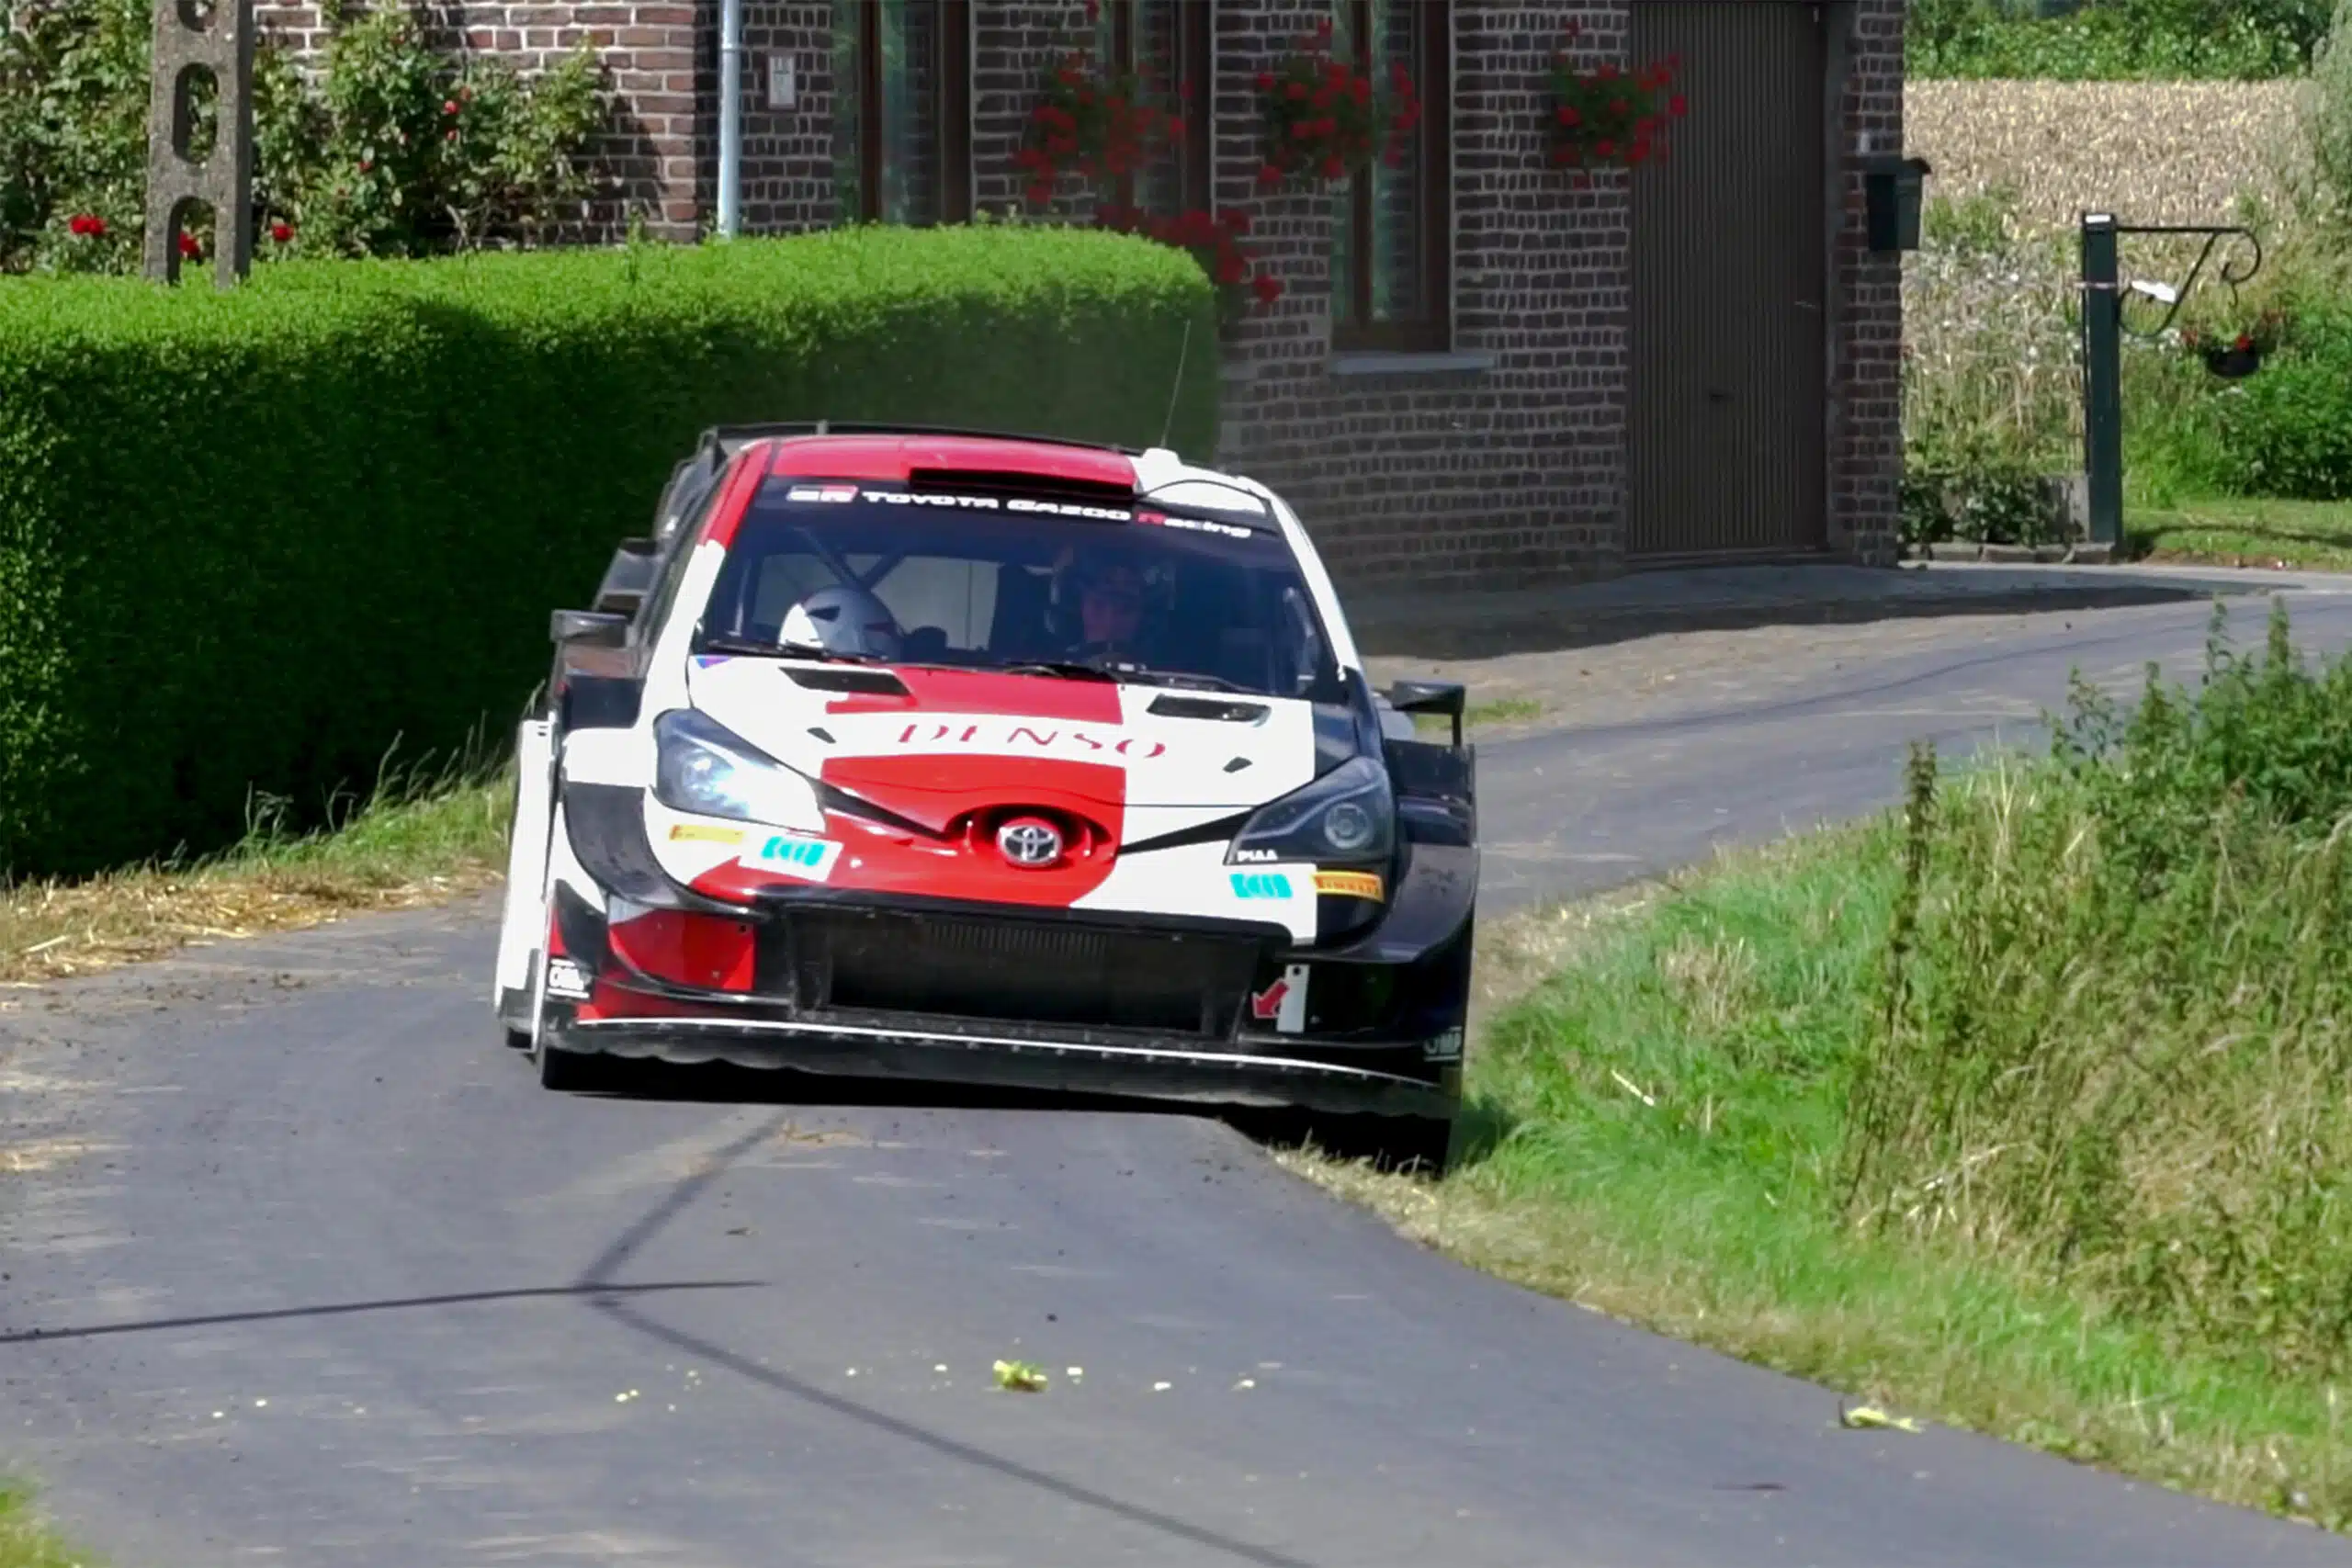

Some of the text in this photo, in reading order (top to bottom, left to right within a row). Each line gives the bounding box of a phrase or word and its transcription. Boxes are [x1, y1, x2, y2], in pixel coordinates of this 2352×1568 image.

[862, 491, 999, 509] TOYOTA
[1007, 499, 1131, 521] GAZOO
[898, 724, 1167, 759] DENSO
[1238, 849, 1278, 862] PIAA
